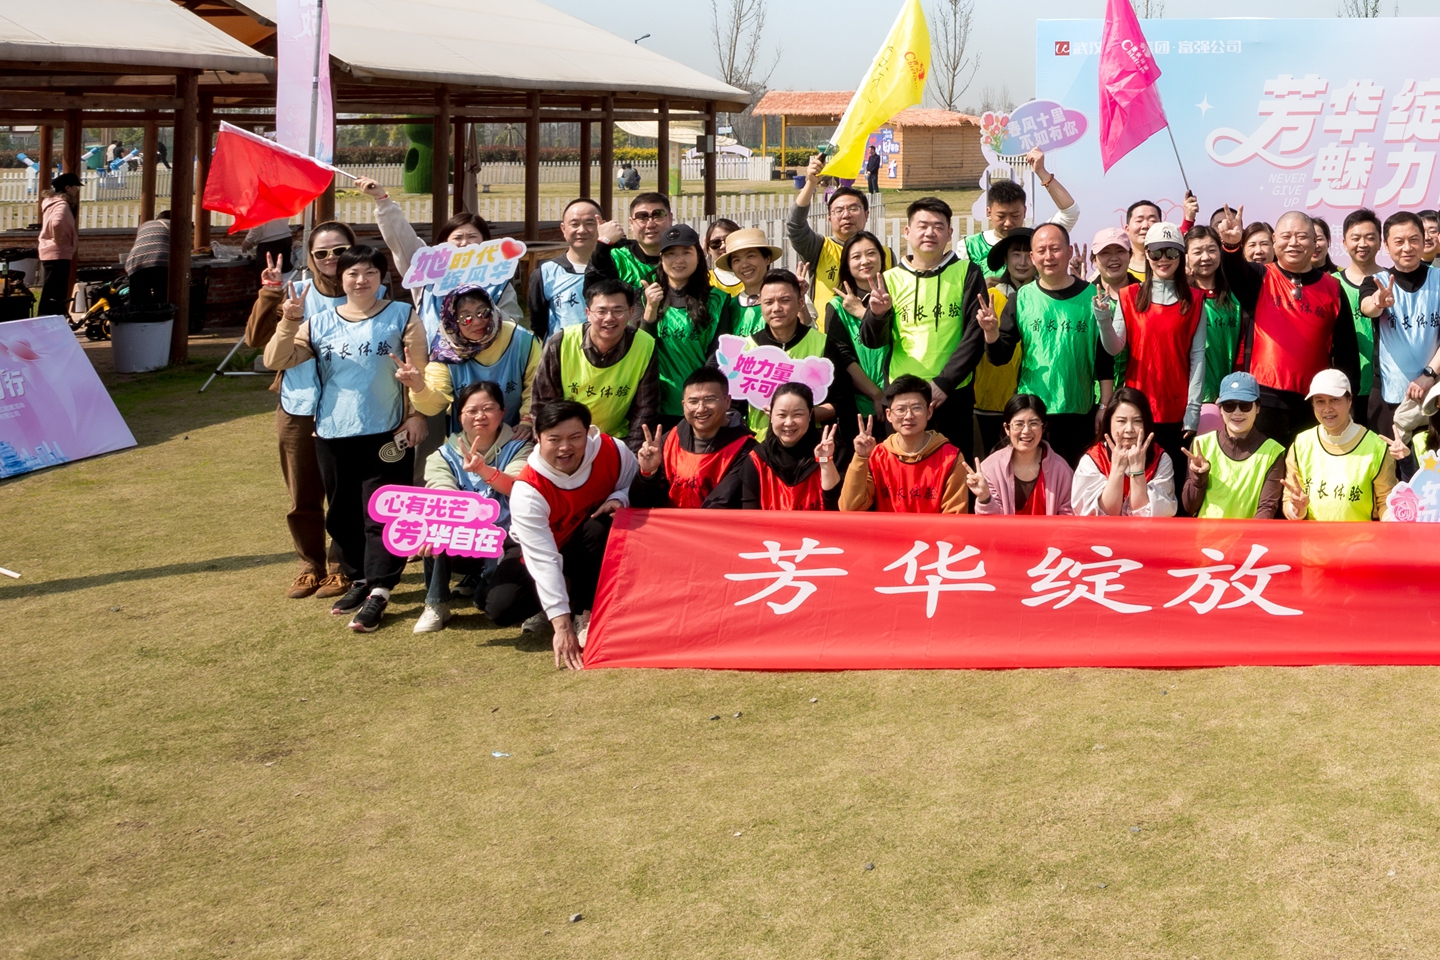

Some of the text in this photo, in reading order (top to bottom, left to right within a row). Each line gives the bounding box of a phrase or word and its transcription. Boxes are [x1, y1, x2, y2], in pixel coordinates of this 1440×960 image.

[1073, 40, 1242, 55] 武汉团·富强公司
[1007, 107, 1066, 138] 春风十里
[1019, 121, 1079, 150] 不如有你
[1268, 173, 1307, 183] NEVER
[1272, 185, 1303, 195] GIVE
[1283, 197, 1300, 208] UP
[409, 242, 500, 284] 她时代
[440, 259, 515, 290] 绽风华
[733, 354, 794, 383] 她力量
[740, 376, 781, 399] 不可
[384, 494, 470, 520] 心有光芒
[393, 520, 502, 553] 芳华自在
[724, 537, 1304, 618] 芳华绽放
